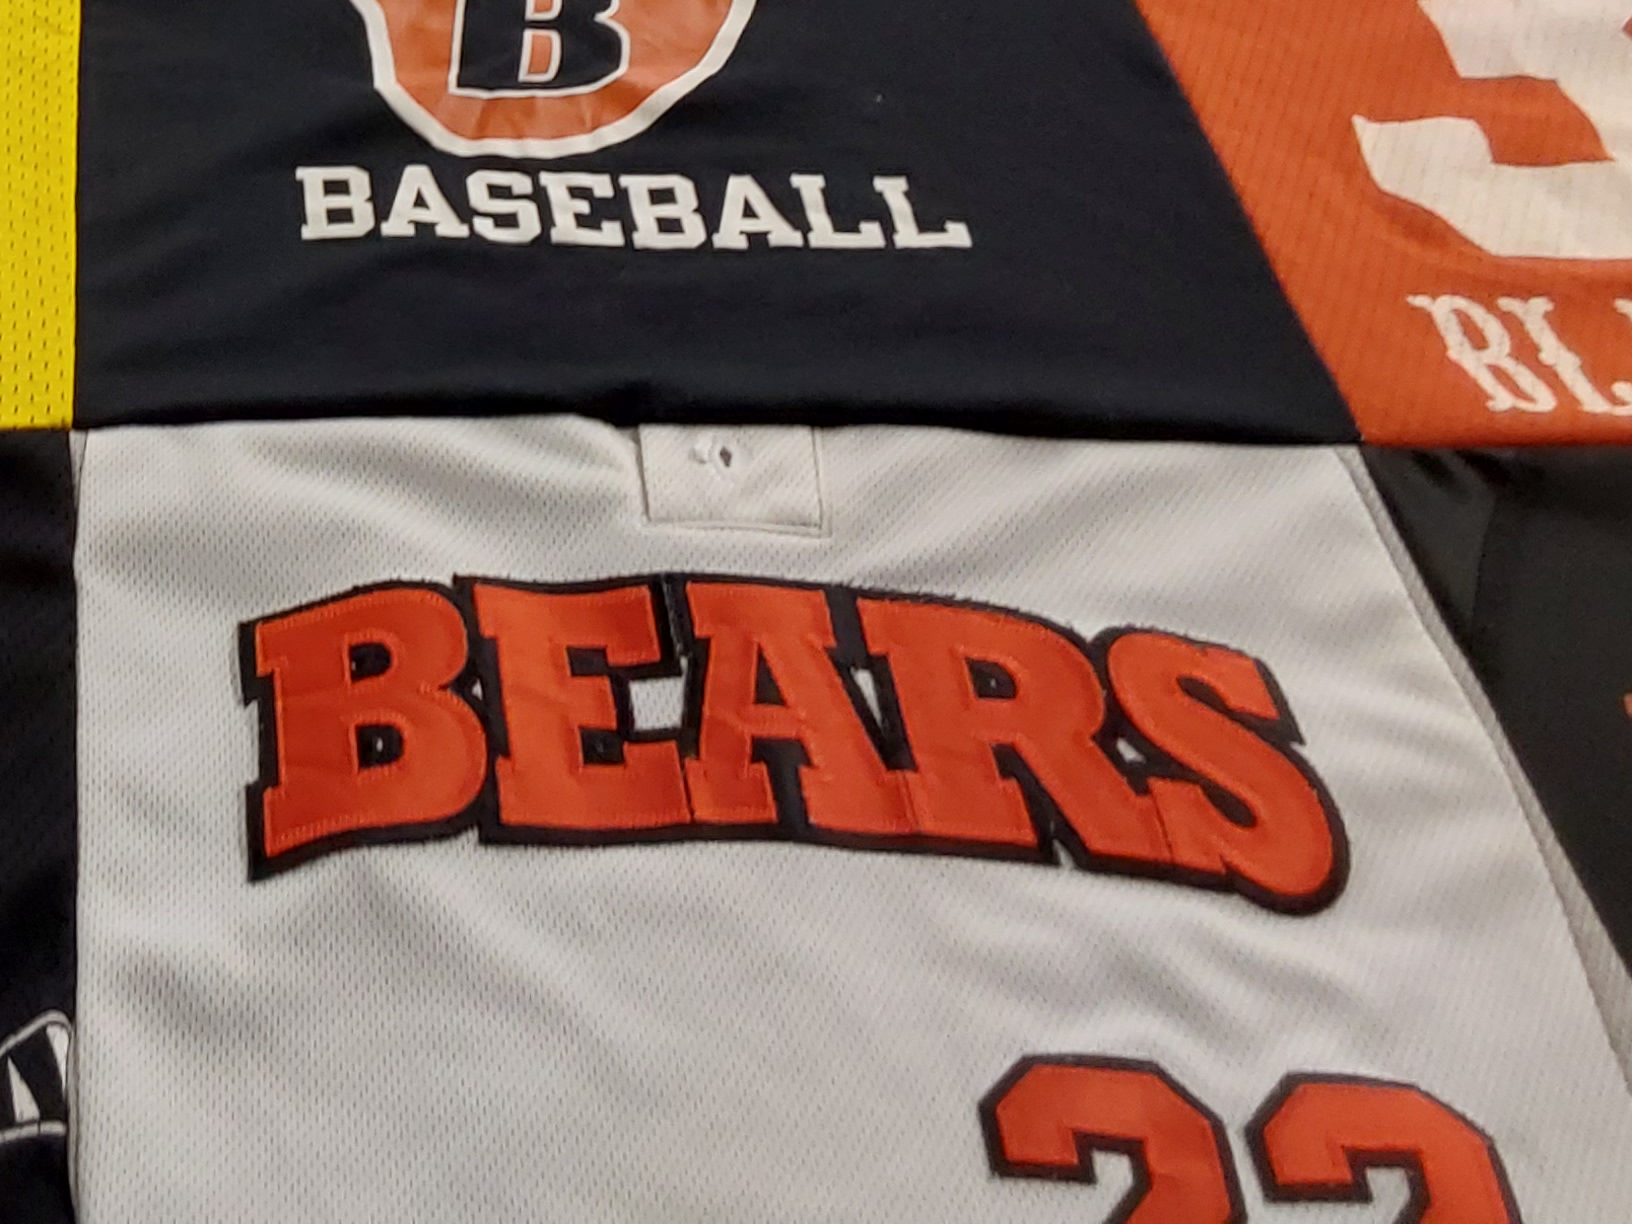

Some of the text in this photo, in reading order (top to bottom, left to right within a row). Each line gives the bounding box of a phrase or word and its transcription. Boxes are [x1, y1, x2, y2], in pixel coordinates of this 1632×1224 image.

[294, 164, 973, 250] BASEBALL
[1406, 292, 1632, 417] BL
[237, 573, 1351, 917] BEARS
